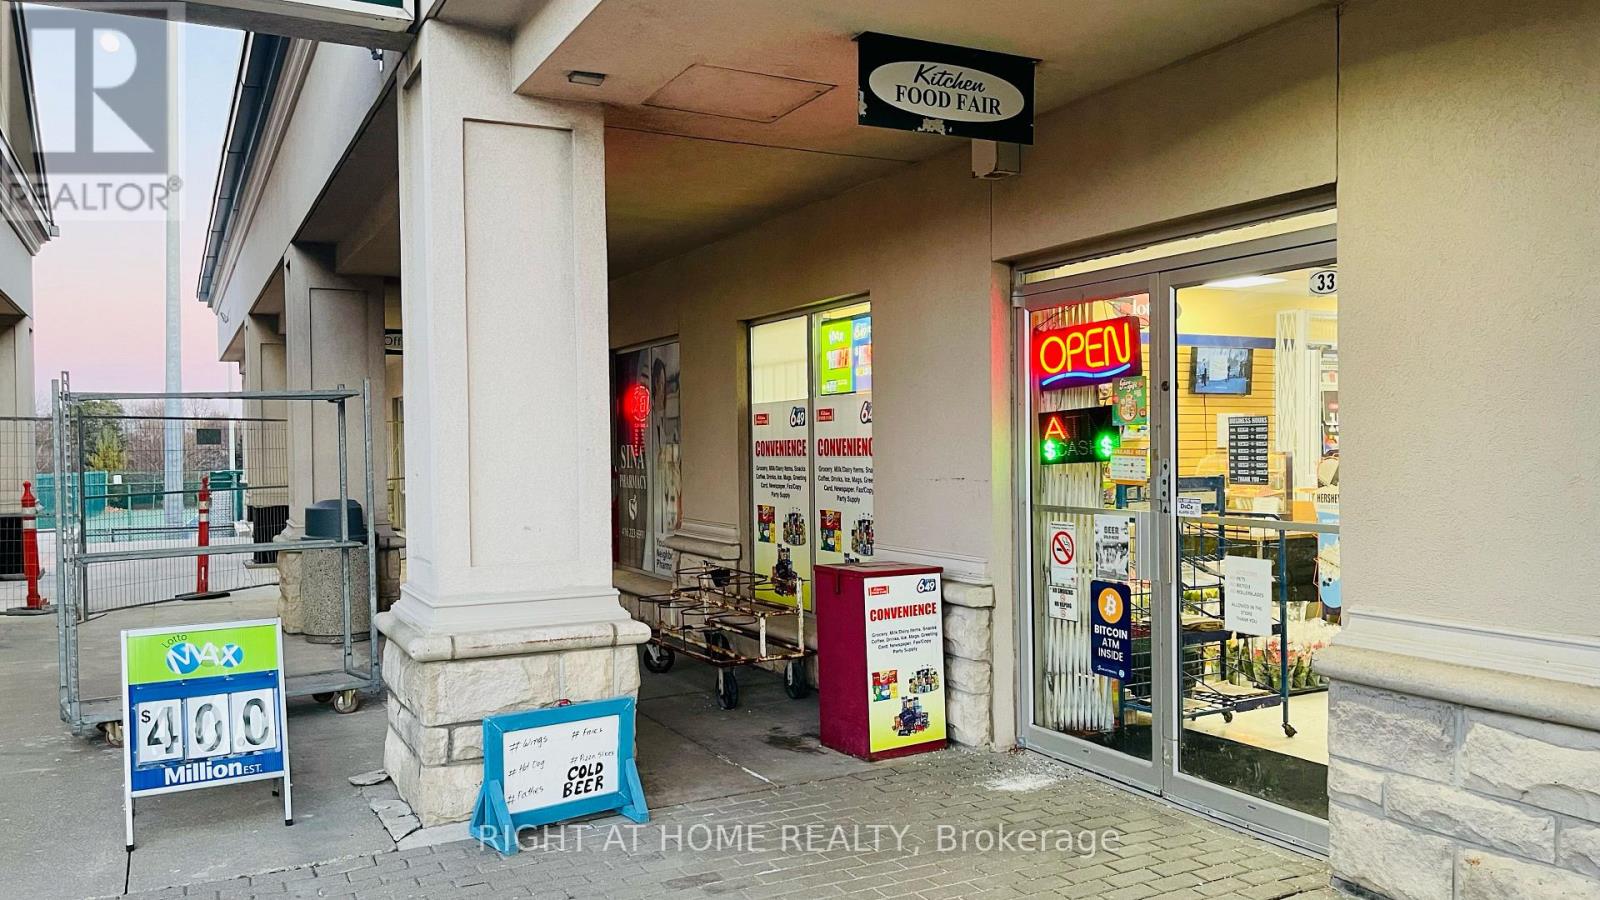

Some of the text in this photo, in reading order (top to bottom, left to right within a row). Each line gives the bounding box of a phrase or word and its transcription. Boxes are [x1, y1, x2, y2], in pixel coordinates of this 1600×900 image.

[914, 64, 986, 92] Kitchen
[895, 85, 1002, 116] FOOD FAIR
[1317, 273, 1335, 291] 33
[1039, 322, 1131, 374] OPEN
[620, 445, 645, 470] SINA
[755, 439, 807, 457] CONVENIENCE
[620, 474, 647, 490] PHARMACY
[1103, 526, 1119, 534] BEER
[869, 602, 937, 622] CONVENIENCE
[162, 633, 188, 649] Lotto
[1094, 623, 1128, 640] BITCOIN
[1102, 637, 1120, 650] ATM
[166, 642, 240, 675] MAX
[1098, 647, 1124, 662] INSIDE
[141, 698, 269, 754] $ 400
[522, 735, 548, 749] Wings
[164, 761, 263, 785] Million EST.
[567, 762, 604, 781] COLD
[562, 775, 604, 798] BEER
